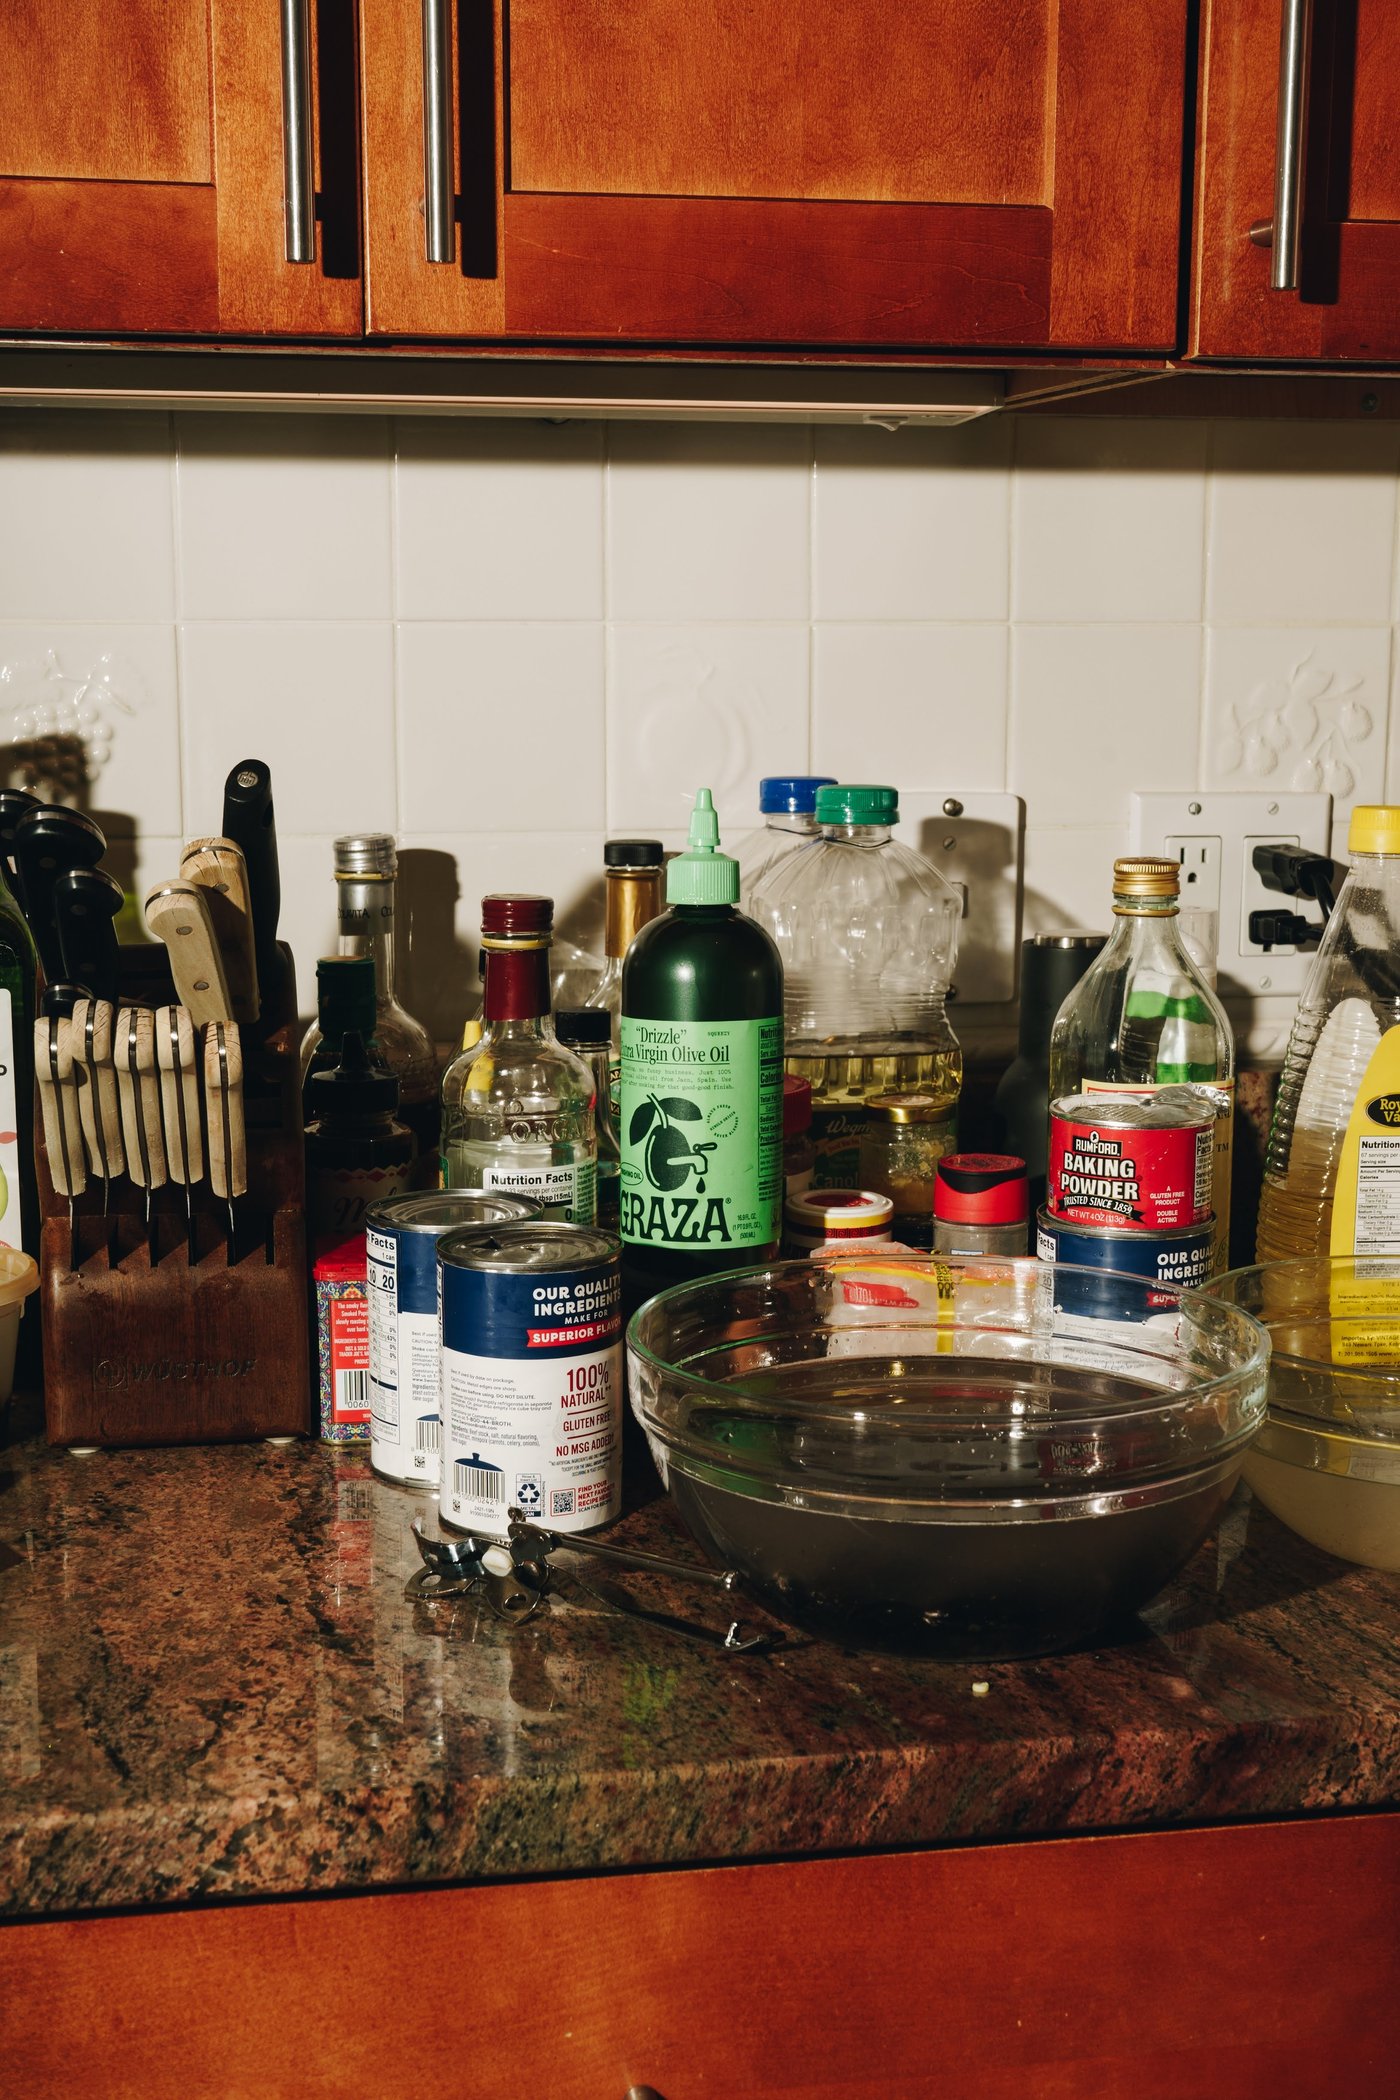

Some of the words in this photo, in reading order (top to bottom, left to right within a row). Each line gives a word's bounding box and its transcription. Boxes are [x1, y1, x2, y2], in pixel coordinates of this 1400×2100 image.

[636, 1044, 668, 1065] Virgin
[672, 1045, 706, 1062] Olive
[710, 1045, 730, 1062] Oil
[1075, 1139, 1118, 1156] RUMFORD
[1064, 1152, 1135, 1178] BAKING
[491, 1175, 542, 1185] Nutrition
[546, 1172, 572, 1183] Facts
[1061, 1173, 1139, 1200] POWDER
[539, 1194, 553, 1202] tbsp
[554, 1191, 573, 1200] (15mL)
[1064, 1195, 1088, 1207] TRUSTED
[1090, 1197, 1112, 1209] SINCE
[1113, 1201, 1133, 1215] 1859
[565, 1208, 572, 1220] 0
[621, 1189, 732, 1242] GRAZA
[1068, 1208, 1079, 1217] NET
[1079, 1210, 1090, 1219] WT
[371, 1236, 395, 1250] Facts
[1157, 1251, 1188, 1266] OUR
[382, 1274, 394, 1290] 20
[1182, 1277, 1202, 1287] MAKE
[532, 1286, 570, 1300] OUR
[534, 1288, 621, 1317] INGREDIENTS
[564, 1315, 591, 1325] MAKE
[593, 1309, 608, 1319] FOR
[532, 1328, 594, 1344] SUPERIOR
[567, 1361, 609, 1392] 100%
[563, 1416, 595, 1432] GLUTEN
[596, 1410, 610, 1425] FREE
[556, 1446, 569, 1457] NO
[571, 1442, 589, 1455] MSG
[578, 1485, 592, 1493] FIND
[593, 1480, 608, 1488] YOUR
[578, 1492, 594, 1500] NEXT
[578, 1497, 598, 1507] RECIPE
